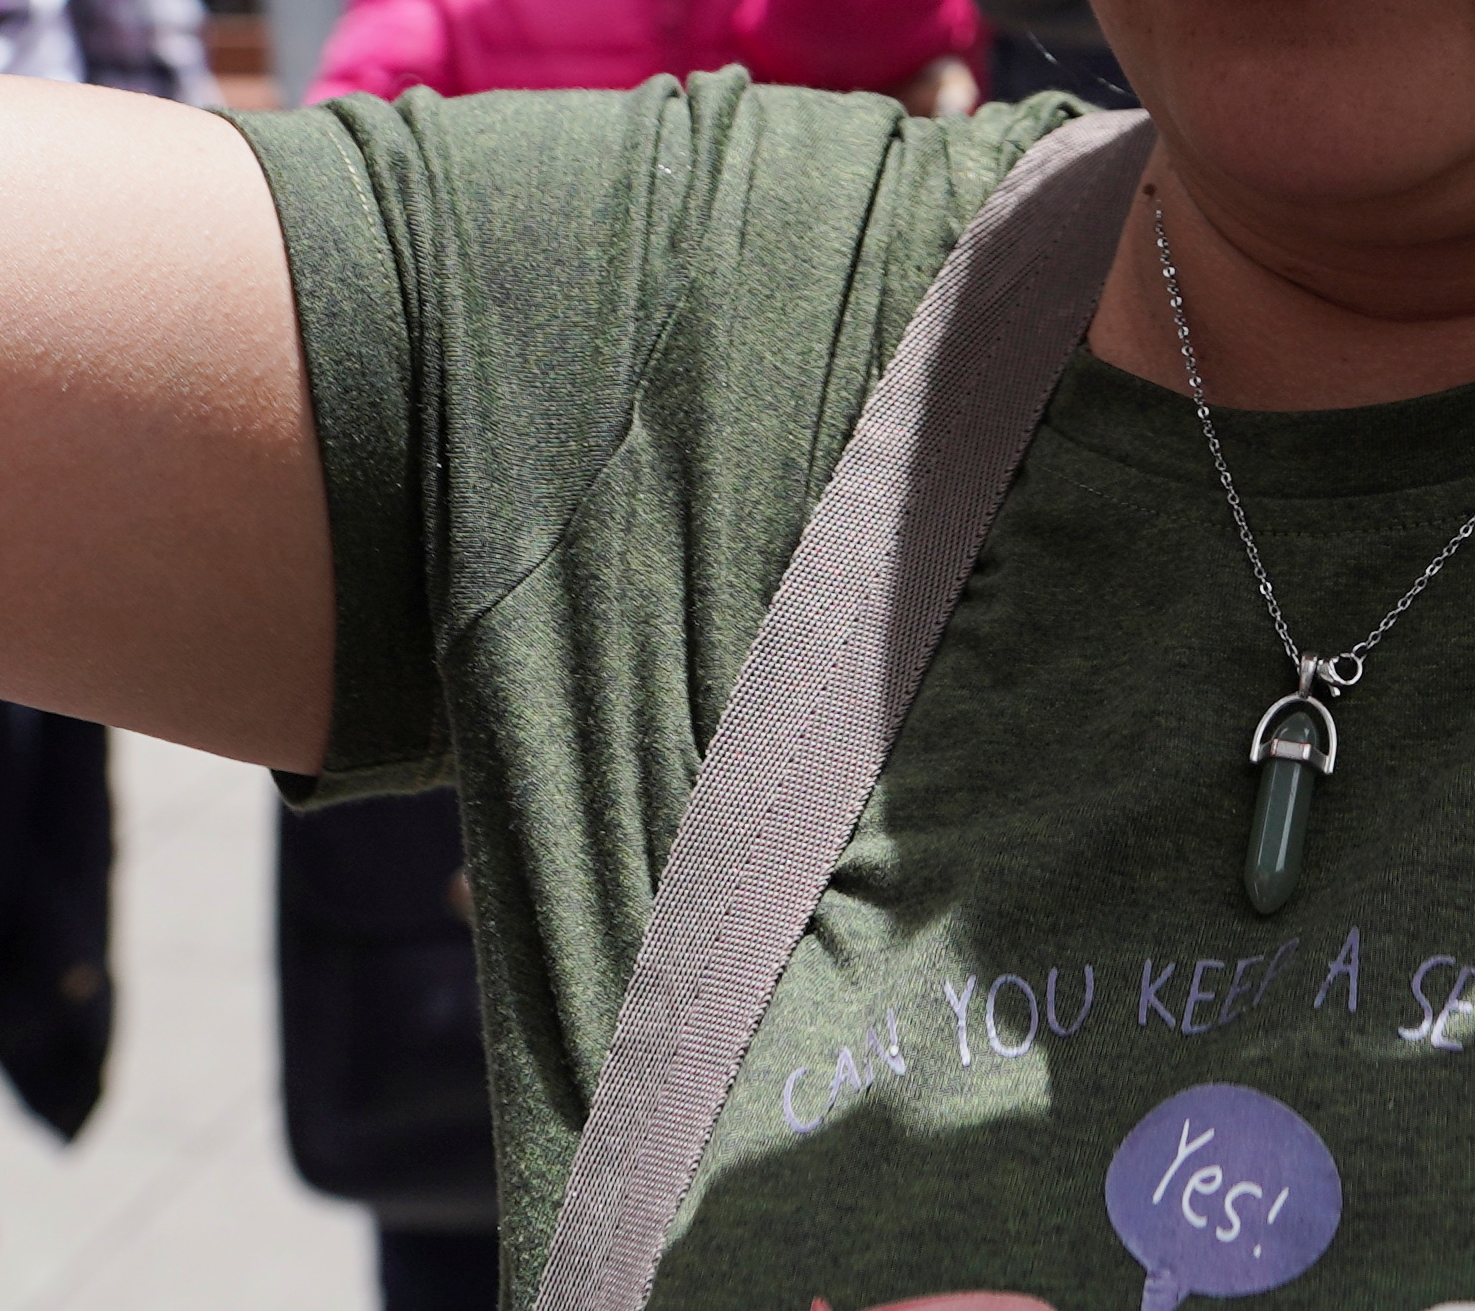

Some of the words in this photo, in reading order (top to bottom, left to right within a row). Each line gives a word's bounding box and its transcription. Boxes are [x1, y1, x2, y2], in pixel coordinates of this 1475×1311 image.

[781, 1005, 908, 1135] CAN
[941, 963, 1096, 1069] YOU
[1312, 924, 1362, 1014] A
[1150, 1117, 1292, 1259] Yes!
